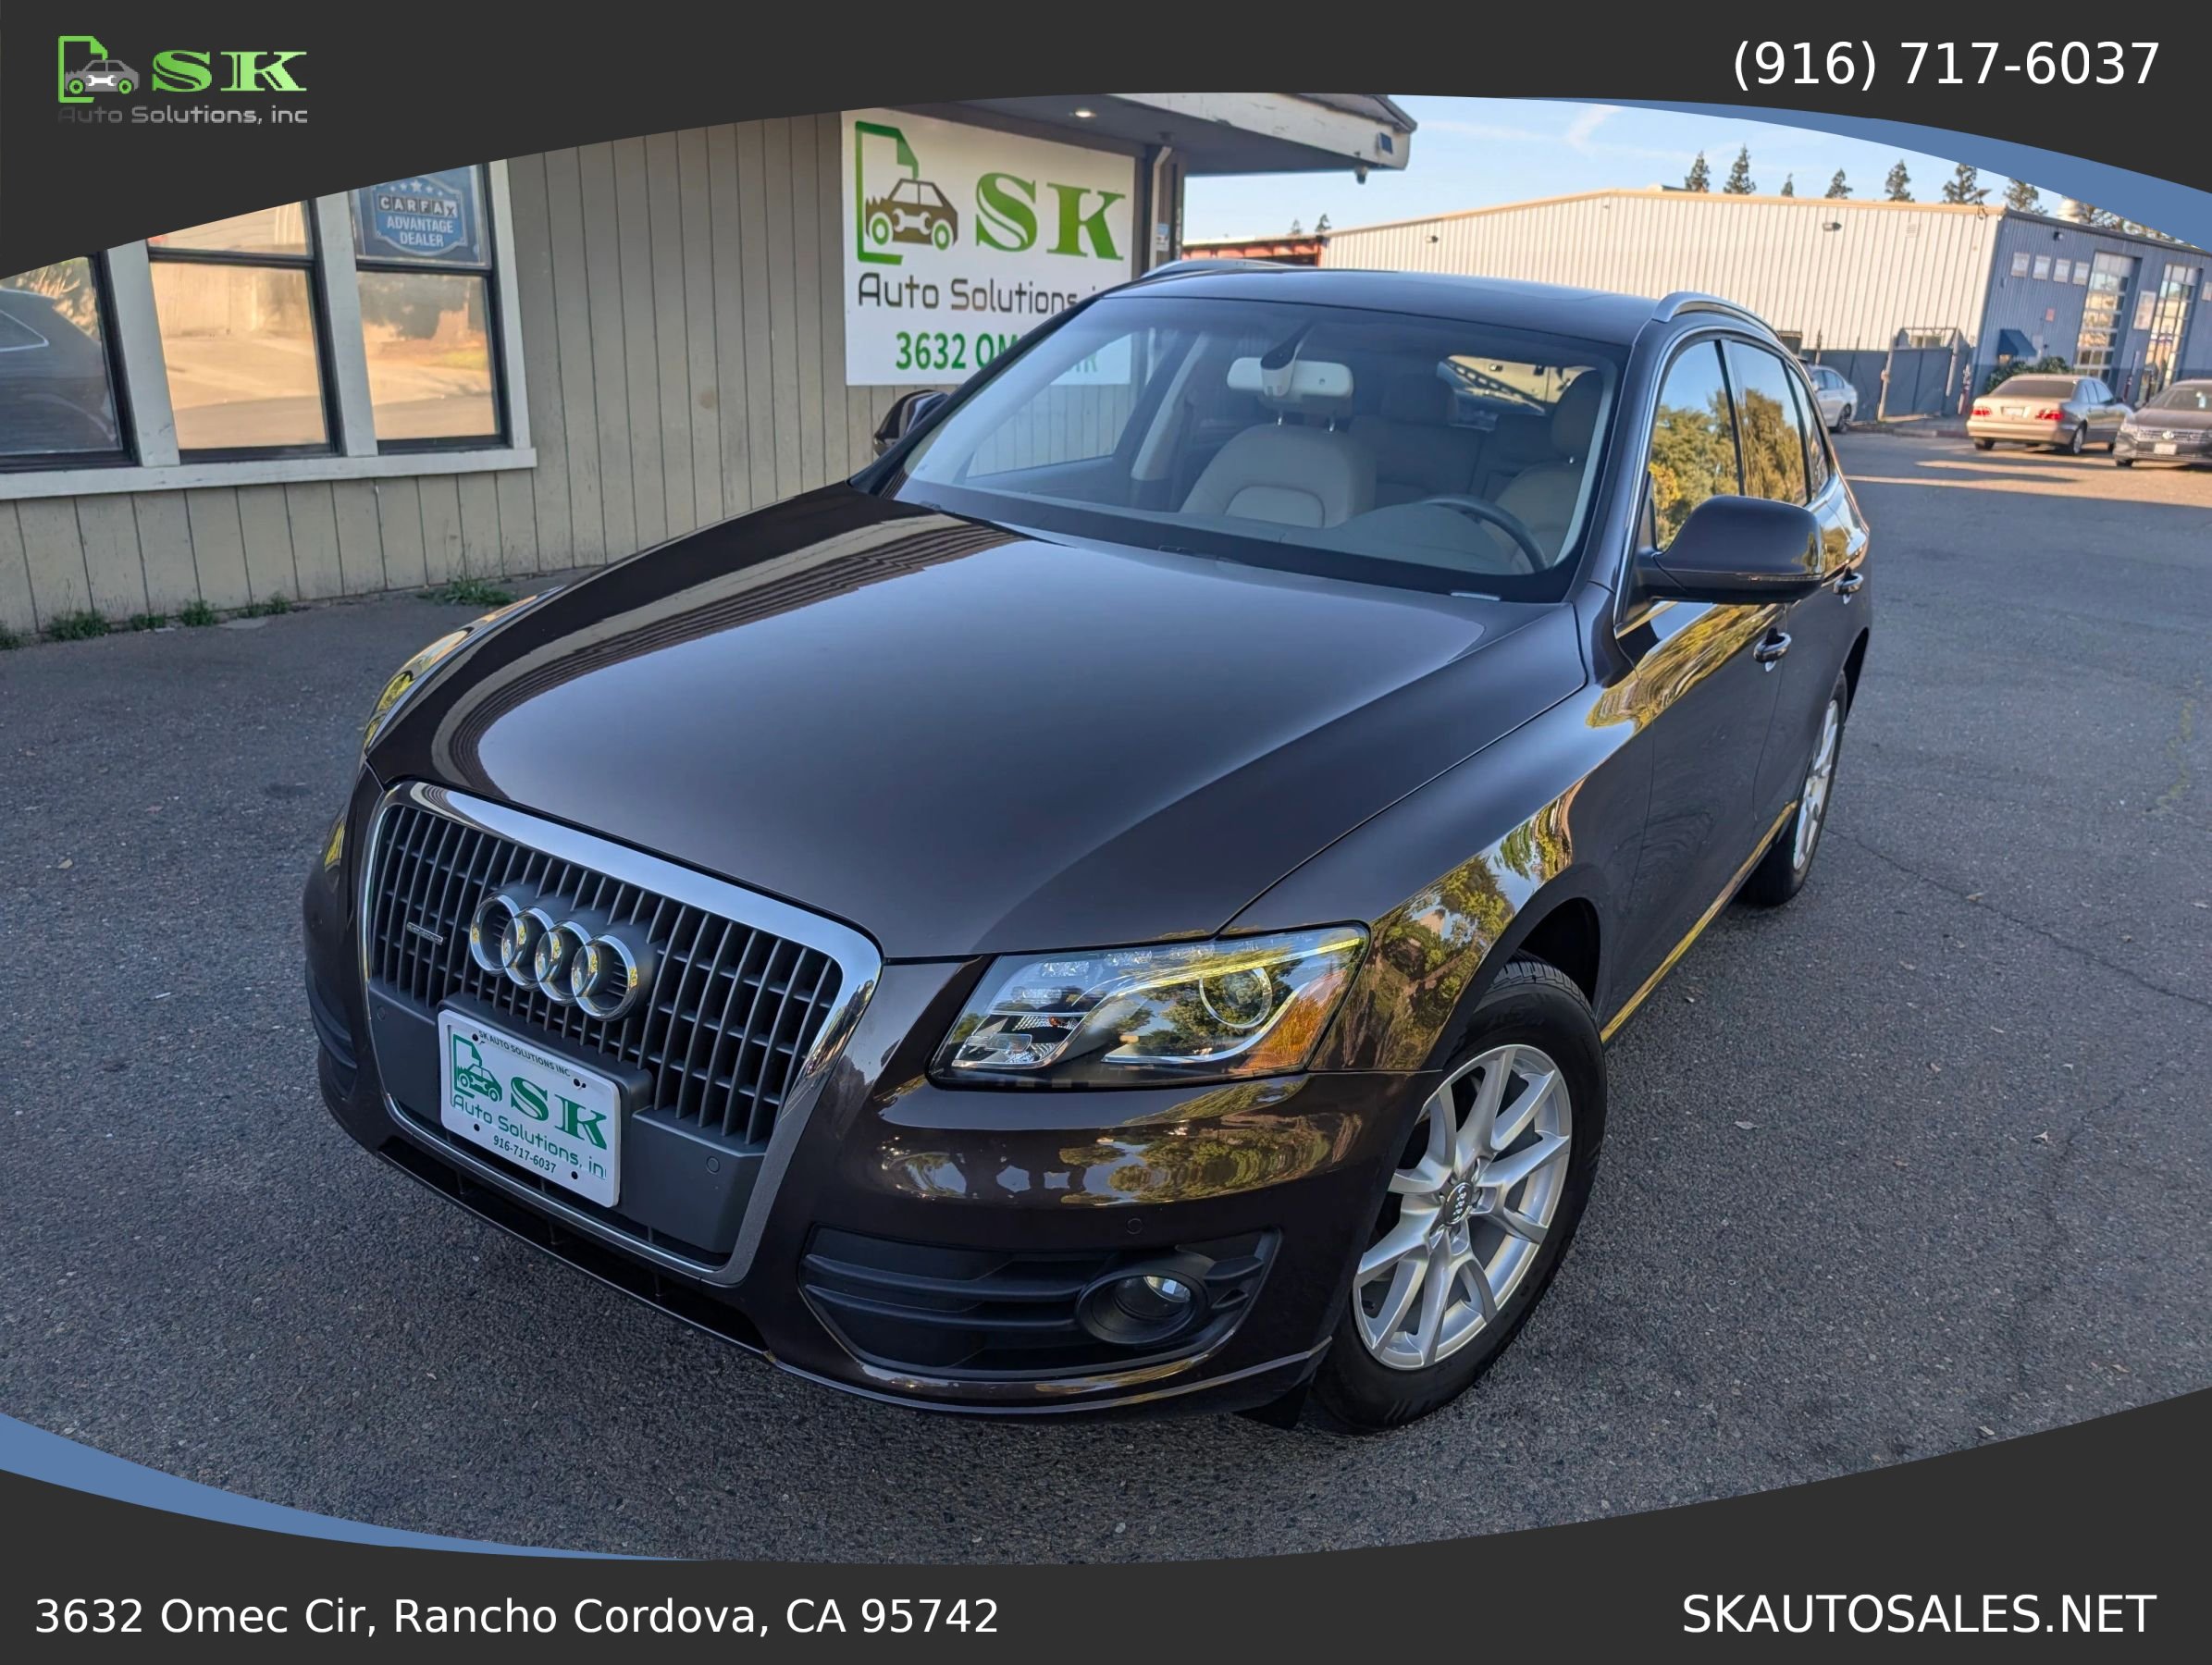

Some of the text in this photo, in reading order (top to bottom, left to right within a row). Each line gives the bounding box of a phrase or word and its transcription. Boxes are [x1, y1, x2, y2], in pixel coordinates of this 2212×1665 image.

[379, 196, 456, 216] CARFAX
[387, 216, 453, 233] ADVANTAGE
[976, 172, 1126, 262] SK
[400, 231, 444, 247] DEALER
[859, 272, 940, 309] Auto
[896, 331, 967, 370] 3632
[478, 1030, 571, 1077] SK AUTO SOLUTIONS INC
[510, 1076, 608, 1151] SK
[452, 1094, 493, 1125] Auto
[588, 1155, 607, 1178] in
[493, 1135, 557, 1174] 916-717-6037
